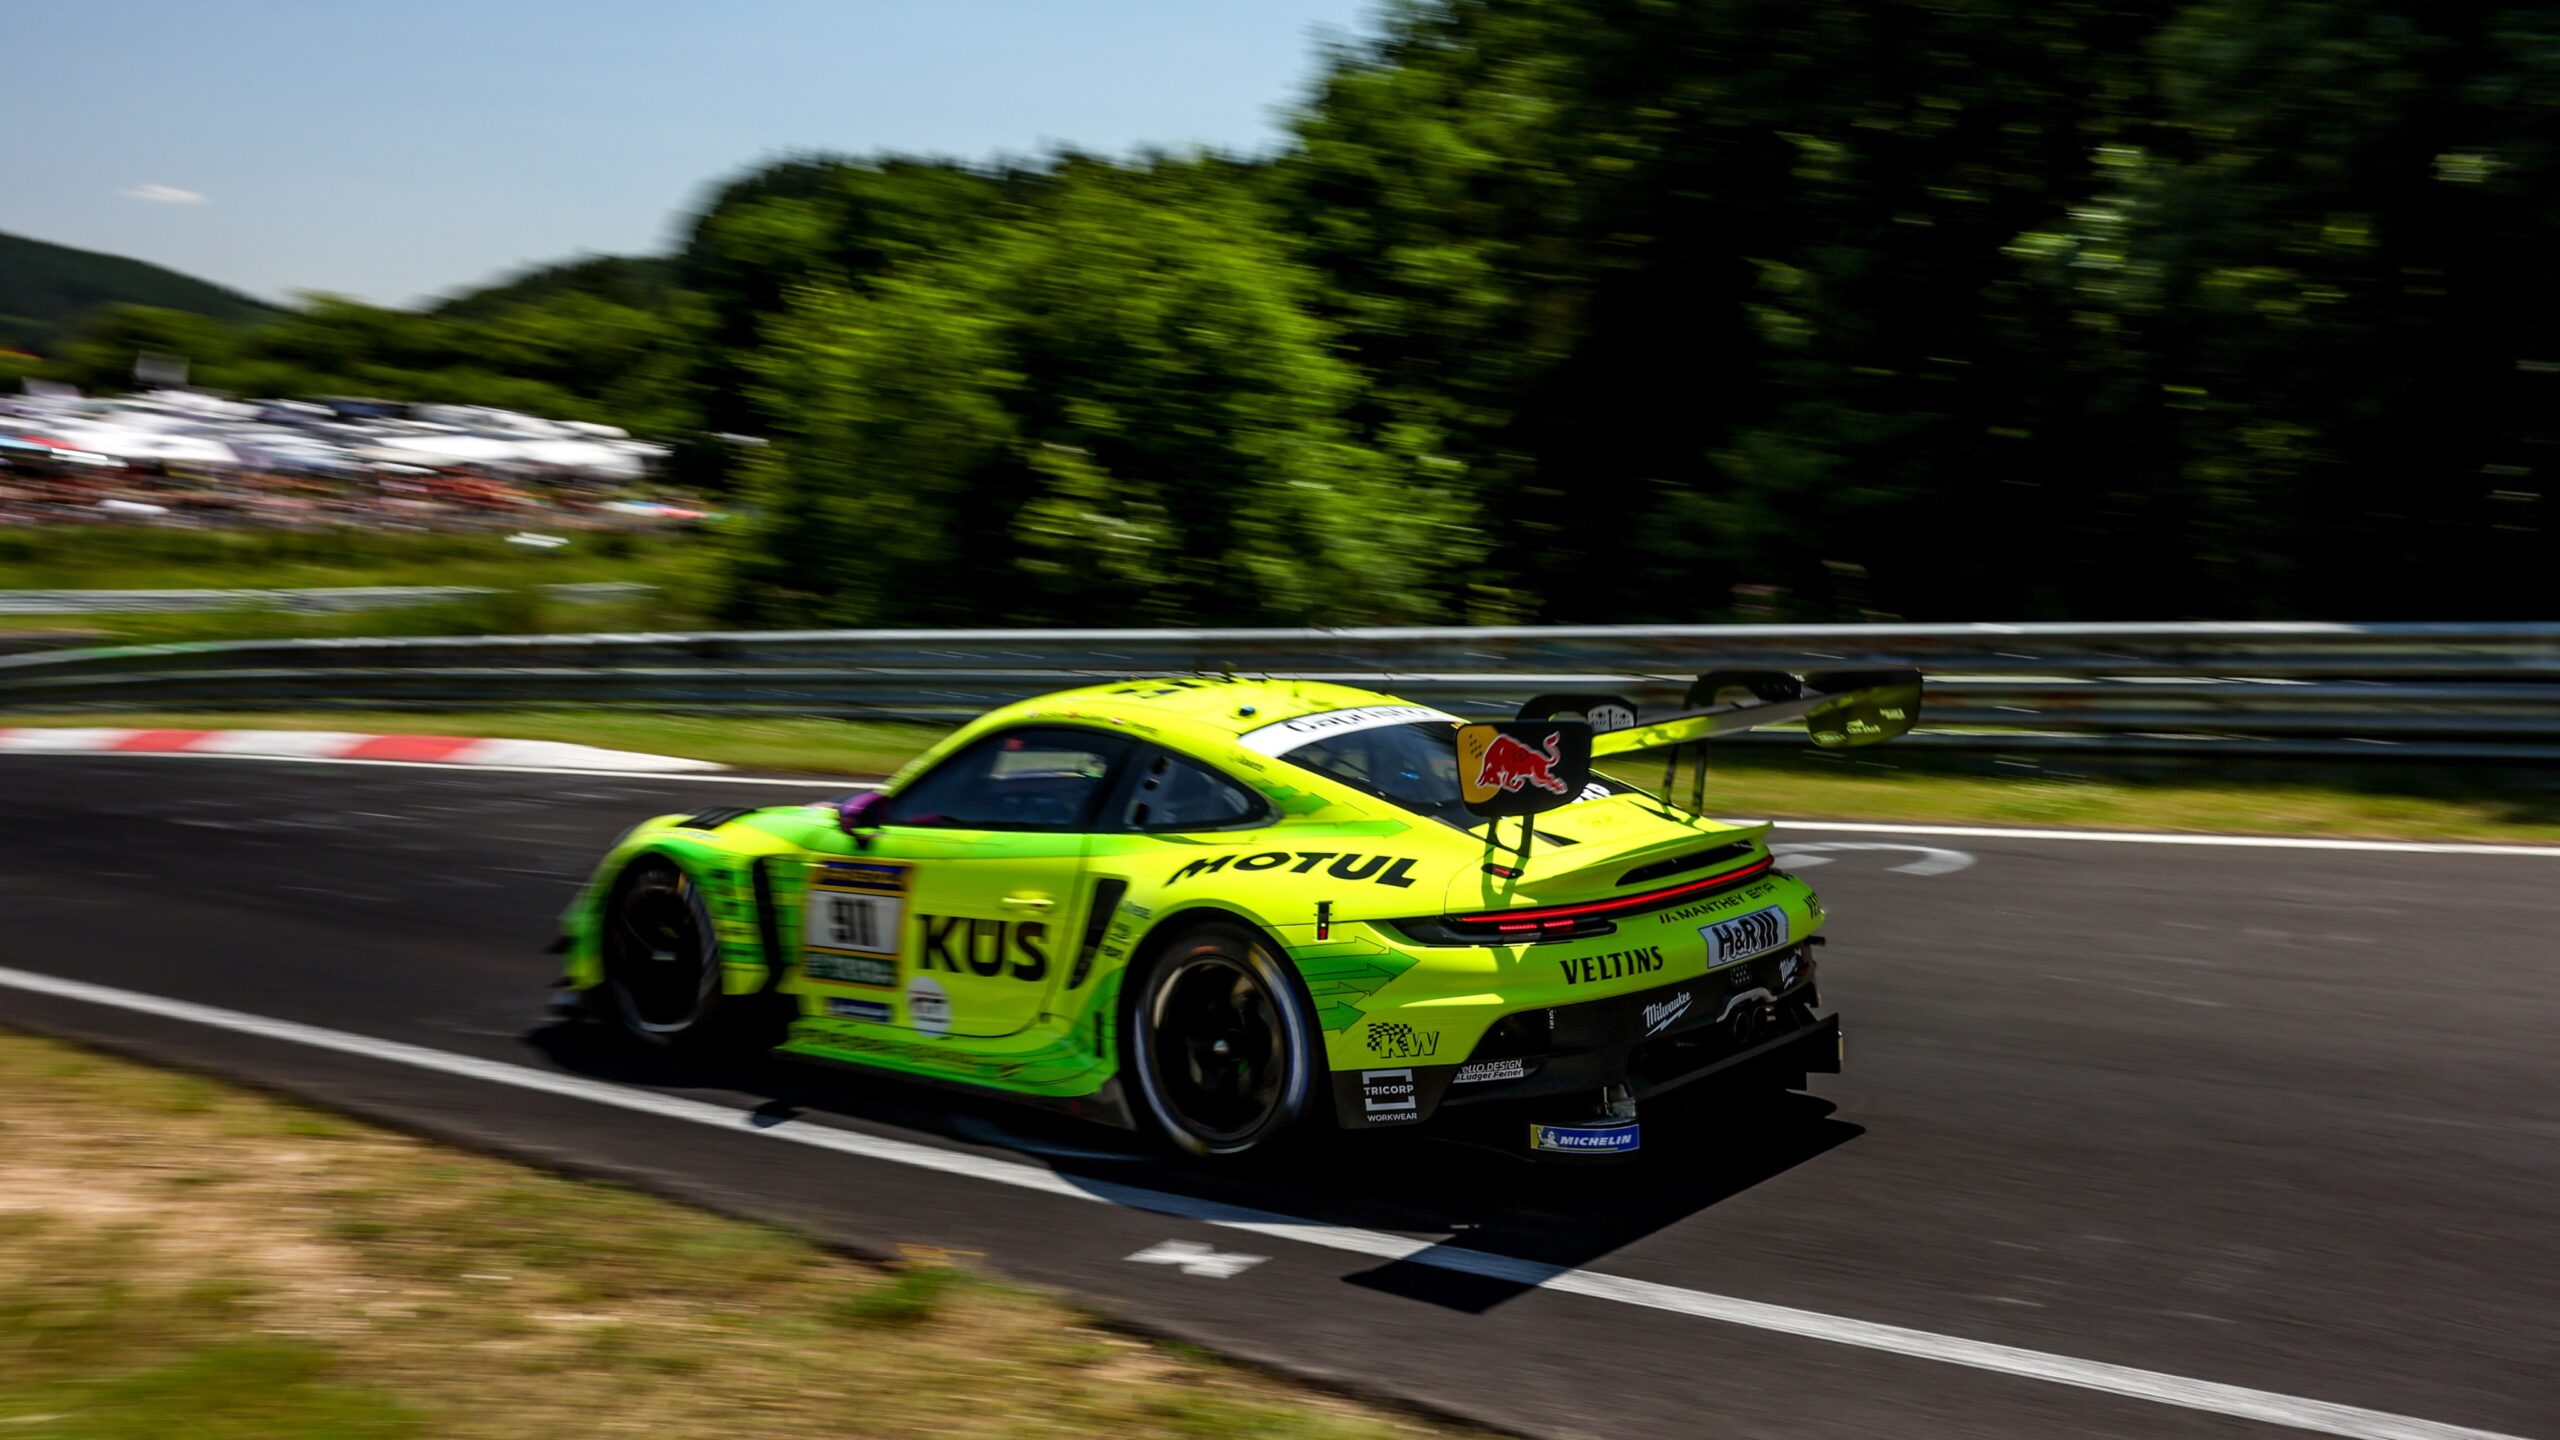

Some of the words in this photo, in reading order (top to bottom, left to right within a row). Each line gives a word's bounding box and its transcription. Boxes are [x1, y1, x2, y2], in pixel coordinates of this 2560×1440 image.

[1164, 851, 1420, 888] MOTUL
[1675, 894, 1746, 922] MANTHEY
[916, 914, 1050, 982] KUS
[1560, 946, 1664, 985] VELTINS
[1642, 991, 1693, 1029] Milwaukee
[1380, 1031, 1439, 1059] KW
[1461, 1070, 1492, 1081] Ludger
[1493, 1069, 1523, 1080] Ferner
[1363, 1083, 1415, 1096] TRICORP
[1367, 1111, 1418, 1123] WORKWEAR
[1559, 1133, 1633, 1147] MICHELIN
